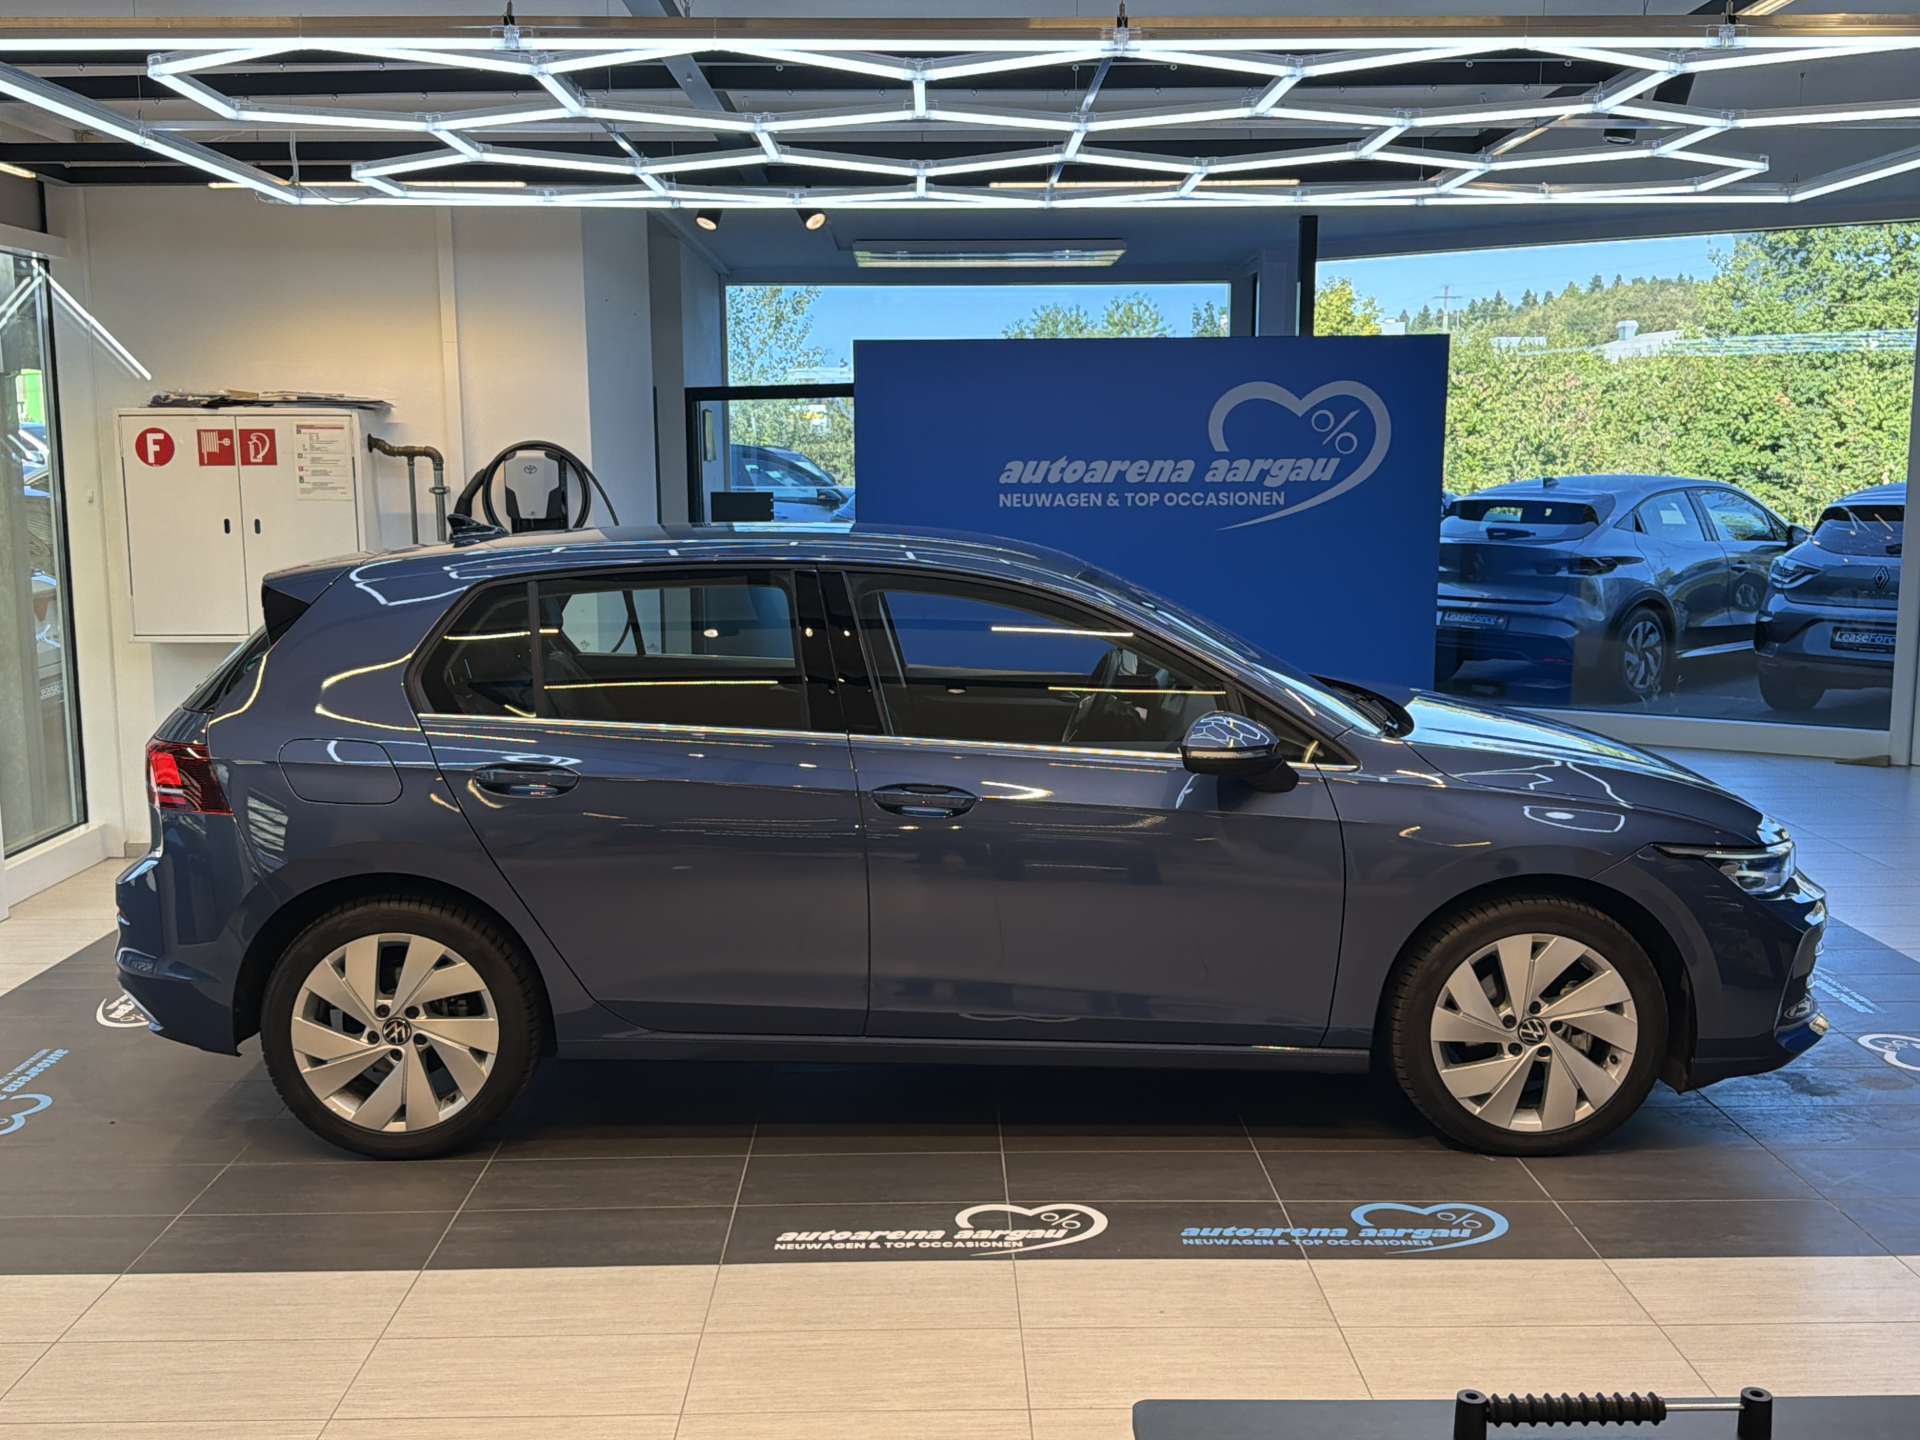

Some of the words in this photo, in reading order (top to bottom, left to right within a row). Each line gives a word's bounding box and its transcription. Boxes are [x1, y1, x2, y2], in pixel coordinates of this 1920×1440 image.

[146, 433, 164, 463] F
[999, 456, 1195, 484] autoarena
[1204, 457, 1340, 487] aargau
[999, 492, 1102, 507] NEUWAGEN
[1106, 492, 1120, 507] &
[1125, 492, 1160, 506] TOP
[1163, 490, 1285, 506] OCCASIONEN
[776, 1229, 946, 1242] autoarena
[953, 1228, 1068, 1240] aargau
[1180, 1226, 1349, 1238] autoarena
[1358, 1226, 1472, 1239] aargau
[774, 1242, 862, 1250] NEUWAGEN
[920, 1240, 1024, 1249] OCCASIONEN
[1182, 1238, 1274, 1246] NEUWAGEN
[1295, 1238, 1323, 1246] TOP
[1328, 1238, 1434, 1247] OCCASIONEN
